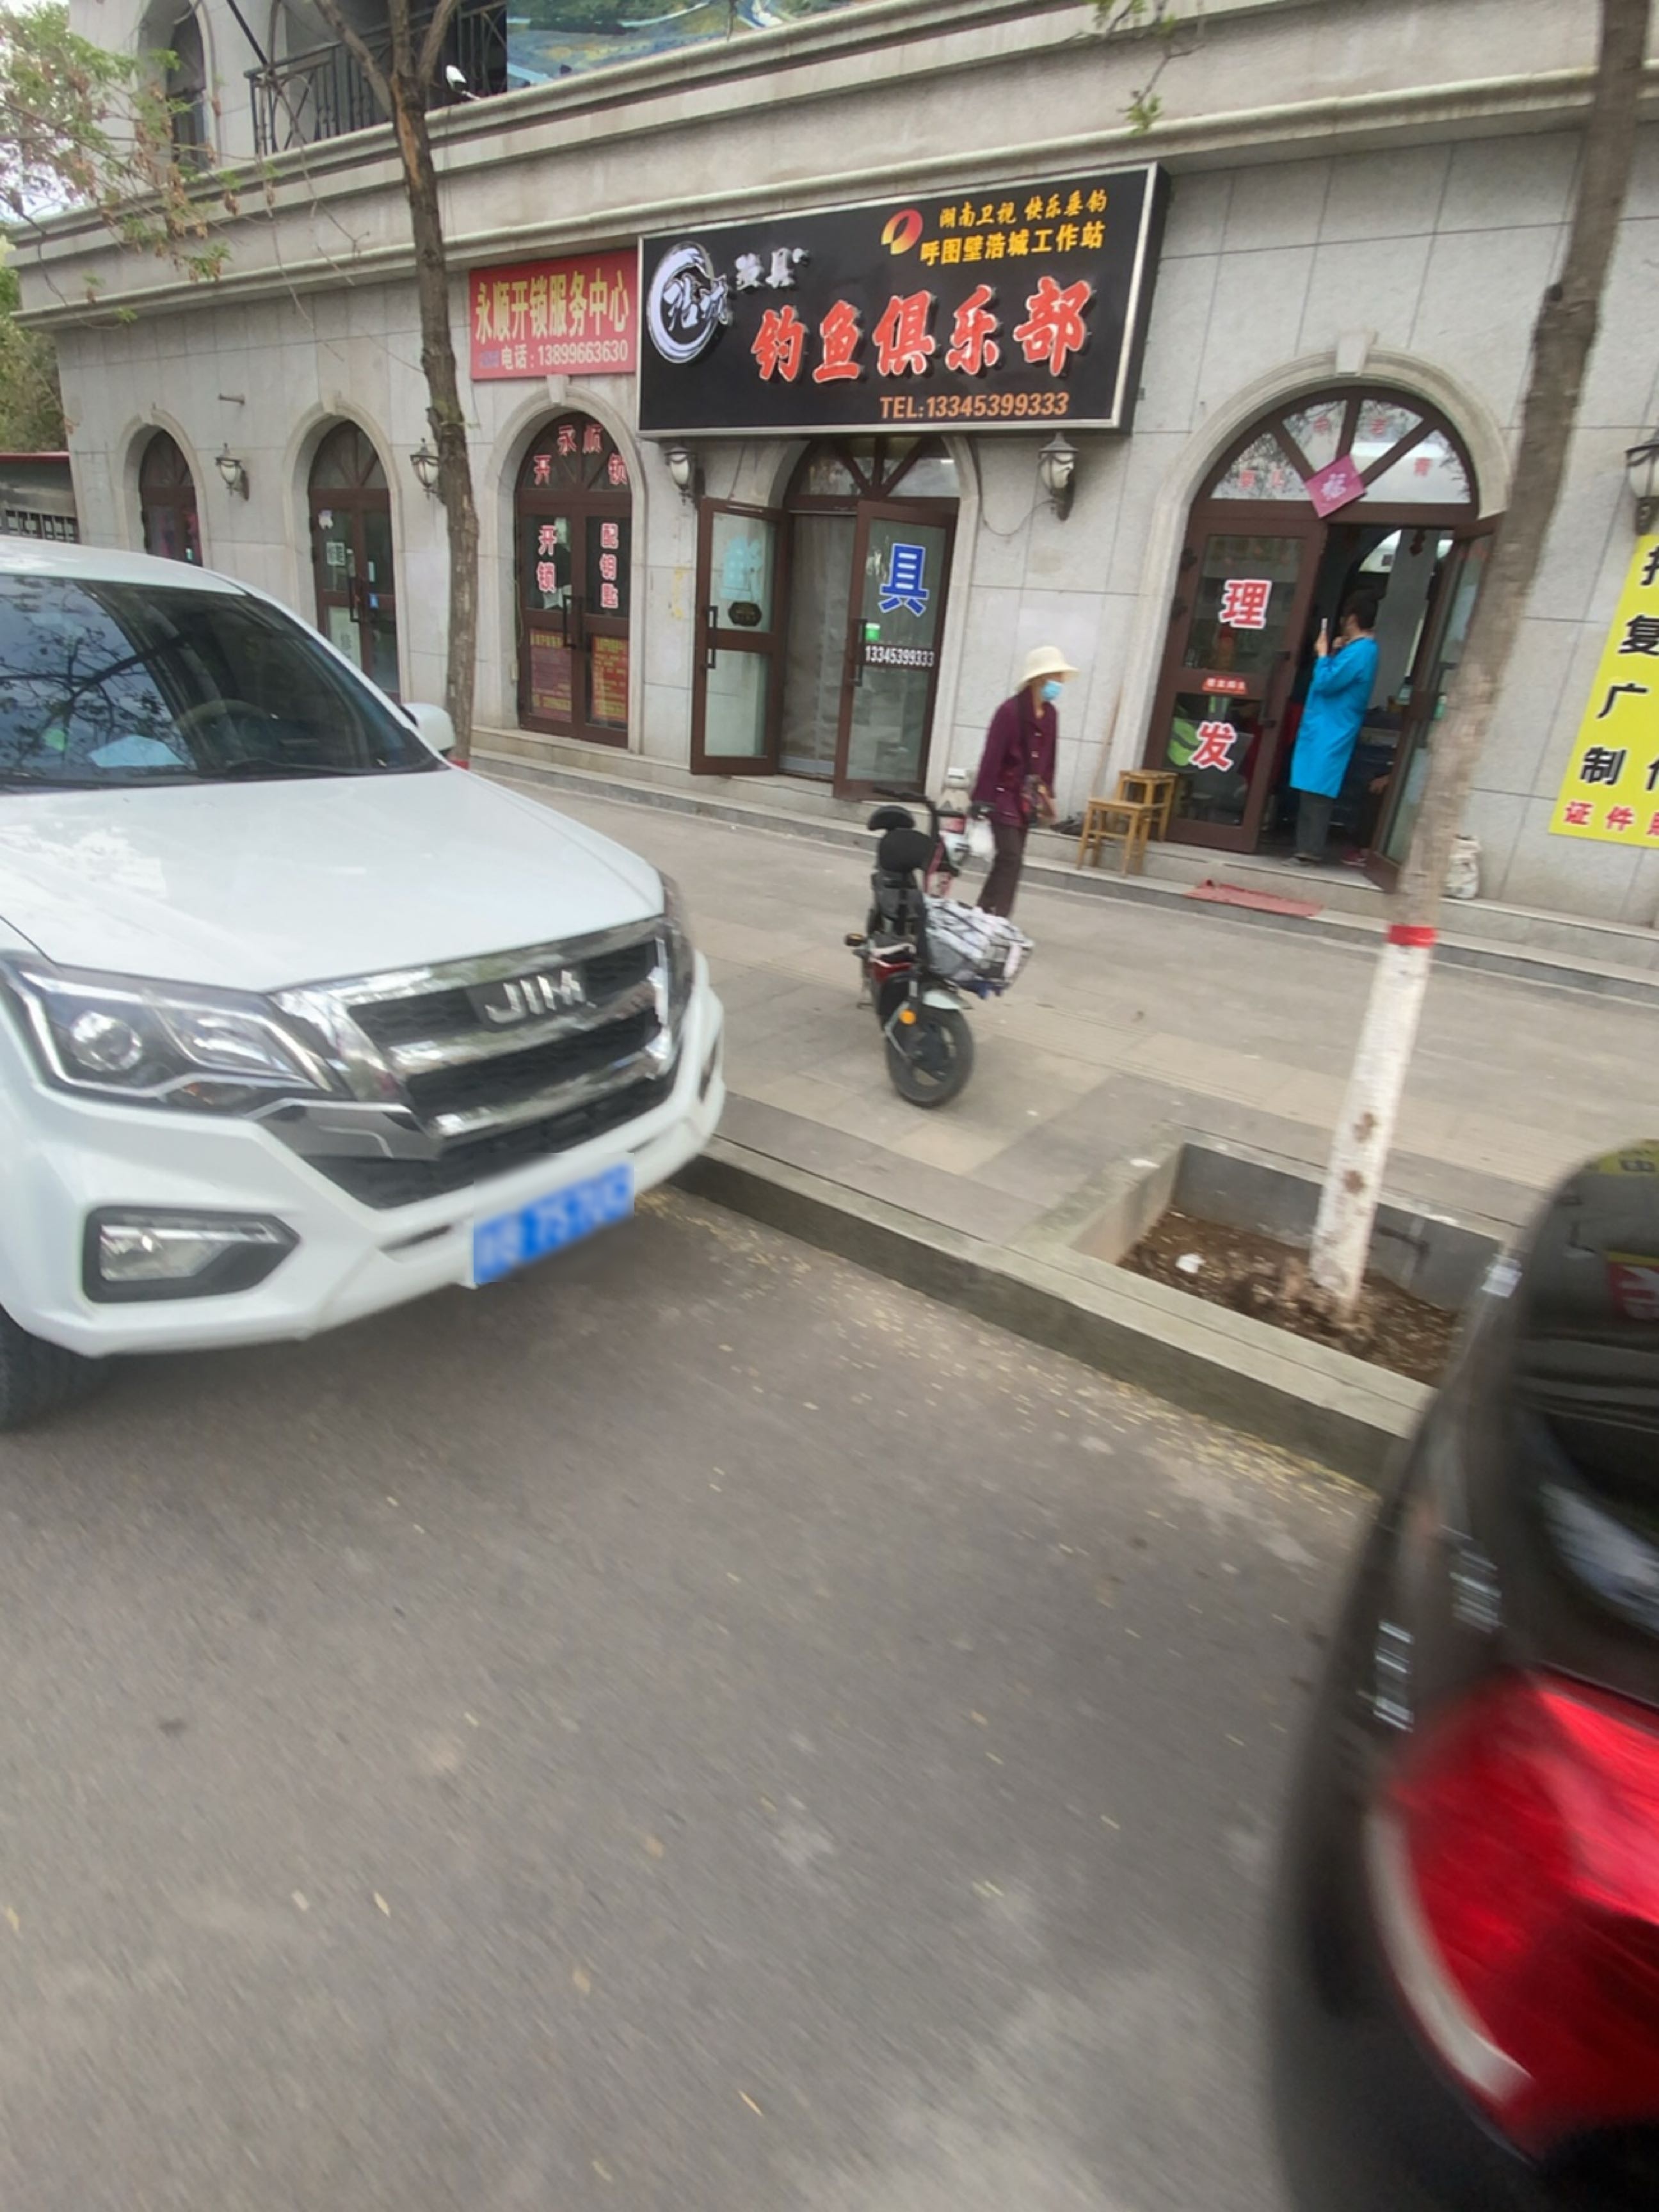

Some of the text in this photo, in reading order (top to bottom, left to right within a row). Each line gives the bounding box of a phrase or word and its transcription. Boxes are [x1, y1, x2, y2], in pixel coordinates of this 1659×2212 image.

[939, 200, 1018, 228] 湖南卫视
[920, 221, 1106, 266] 呼图壁浩城工作站
[751, 276, 1091, 383] 钓鱼俱乐部
[879, 392, 1070, 419] TEL:13345399333
[878, 543, 930, 618] 具
[865, 645, 936, 668] 13345399333
[1579, 746, 1659, 792] 制
